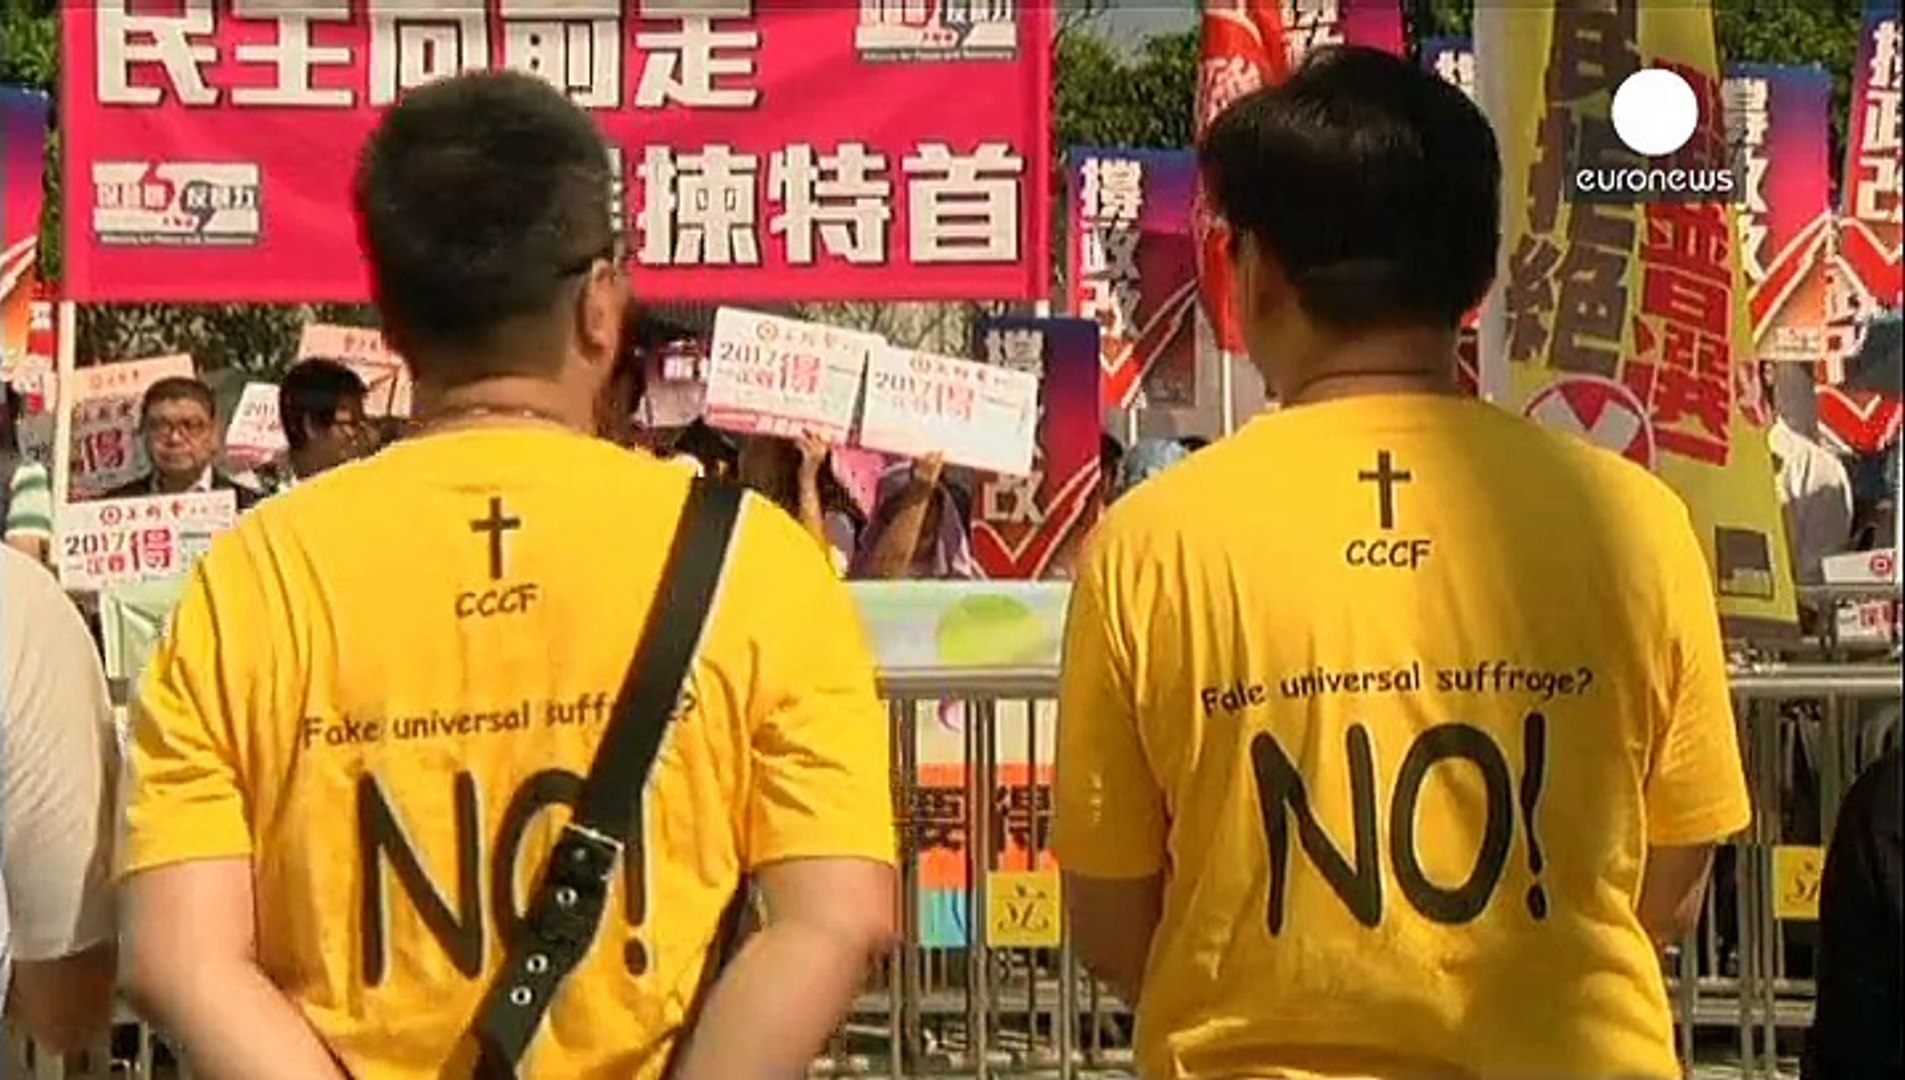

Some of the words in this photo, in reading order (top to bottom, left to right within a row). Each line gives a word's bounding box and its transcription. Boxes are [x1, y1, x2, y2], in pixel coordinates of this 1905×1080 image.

[608, 143, 1024, 264] 揀特首
[720, 341, 777, 368] 2017
[875, 371, 932, 394] 2017
[64, 530, 125, 556] 2017
[1346, 540, 1432, 571] CCCF
[455, 583, 538, 618] CCCF
[1281, 662, 1420, 698] universal
[1436, 660, 1593, 700] suffrage?
[303, 716, 379, 749] Fake
[392, 701, 529, 739] universal
[1251, 711, 1547, 937] NO!
